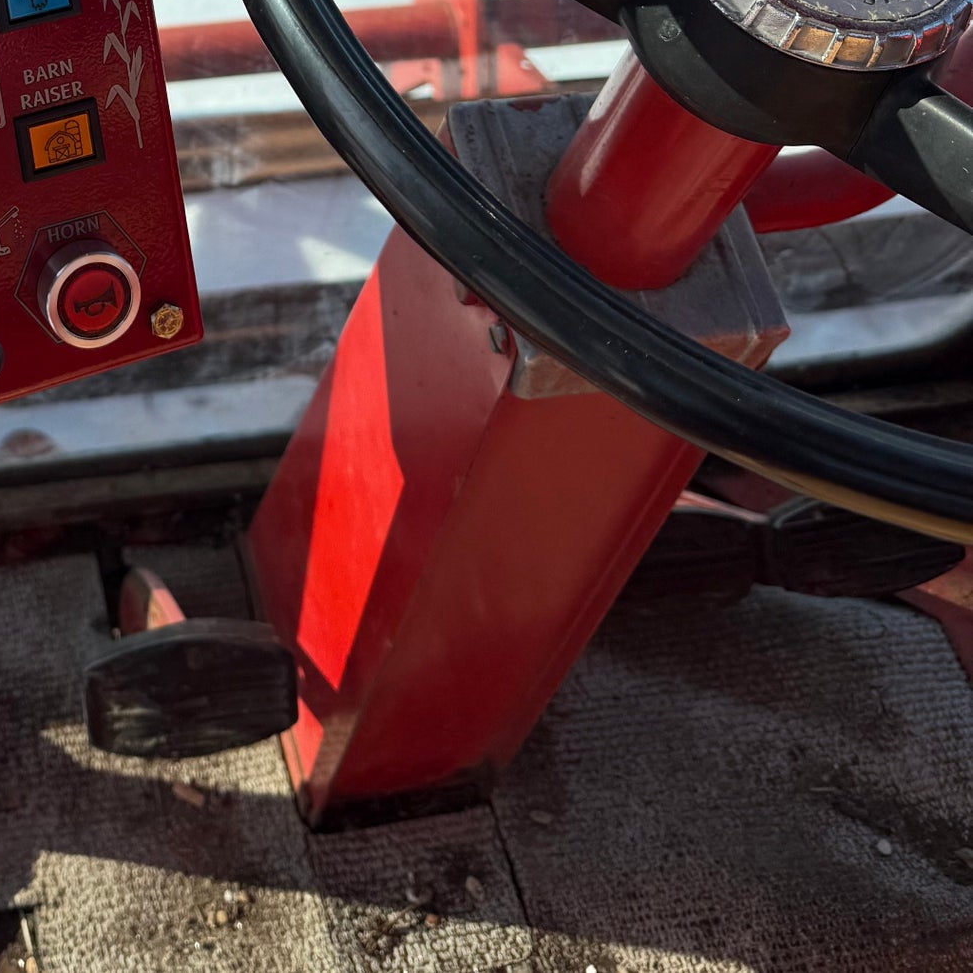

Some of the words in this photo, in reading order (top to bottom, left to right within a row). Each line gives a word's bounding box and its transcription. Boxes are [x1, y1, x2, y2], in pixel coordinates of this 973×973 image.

[23, 58, 74, 86] BARN
[19, 80, 84, 111] RAISER
[47, 215, 100, 243] HORN
